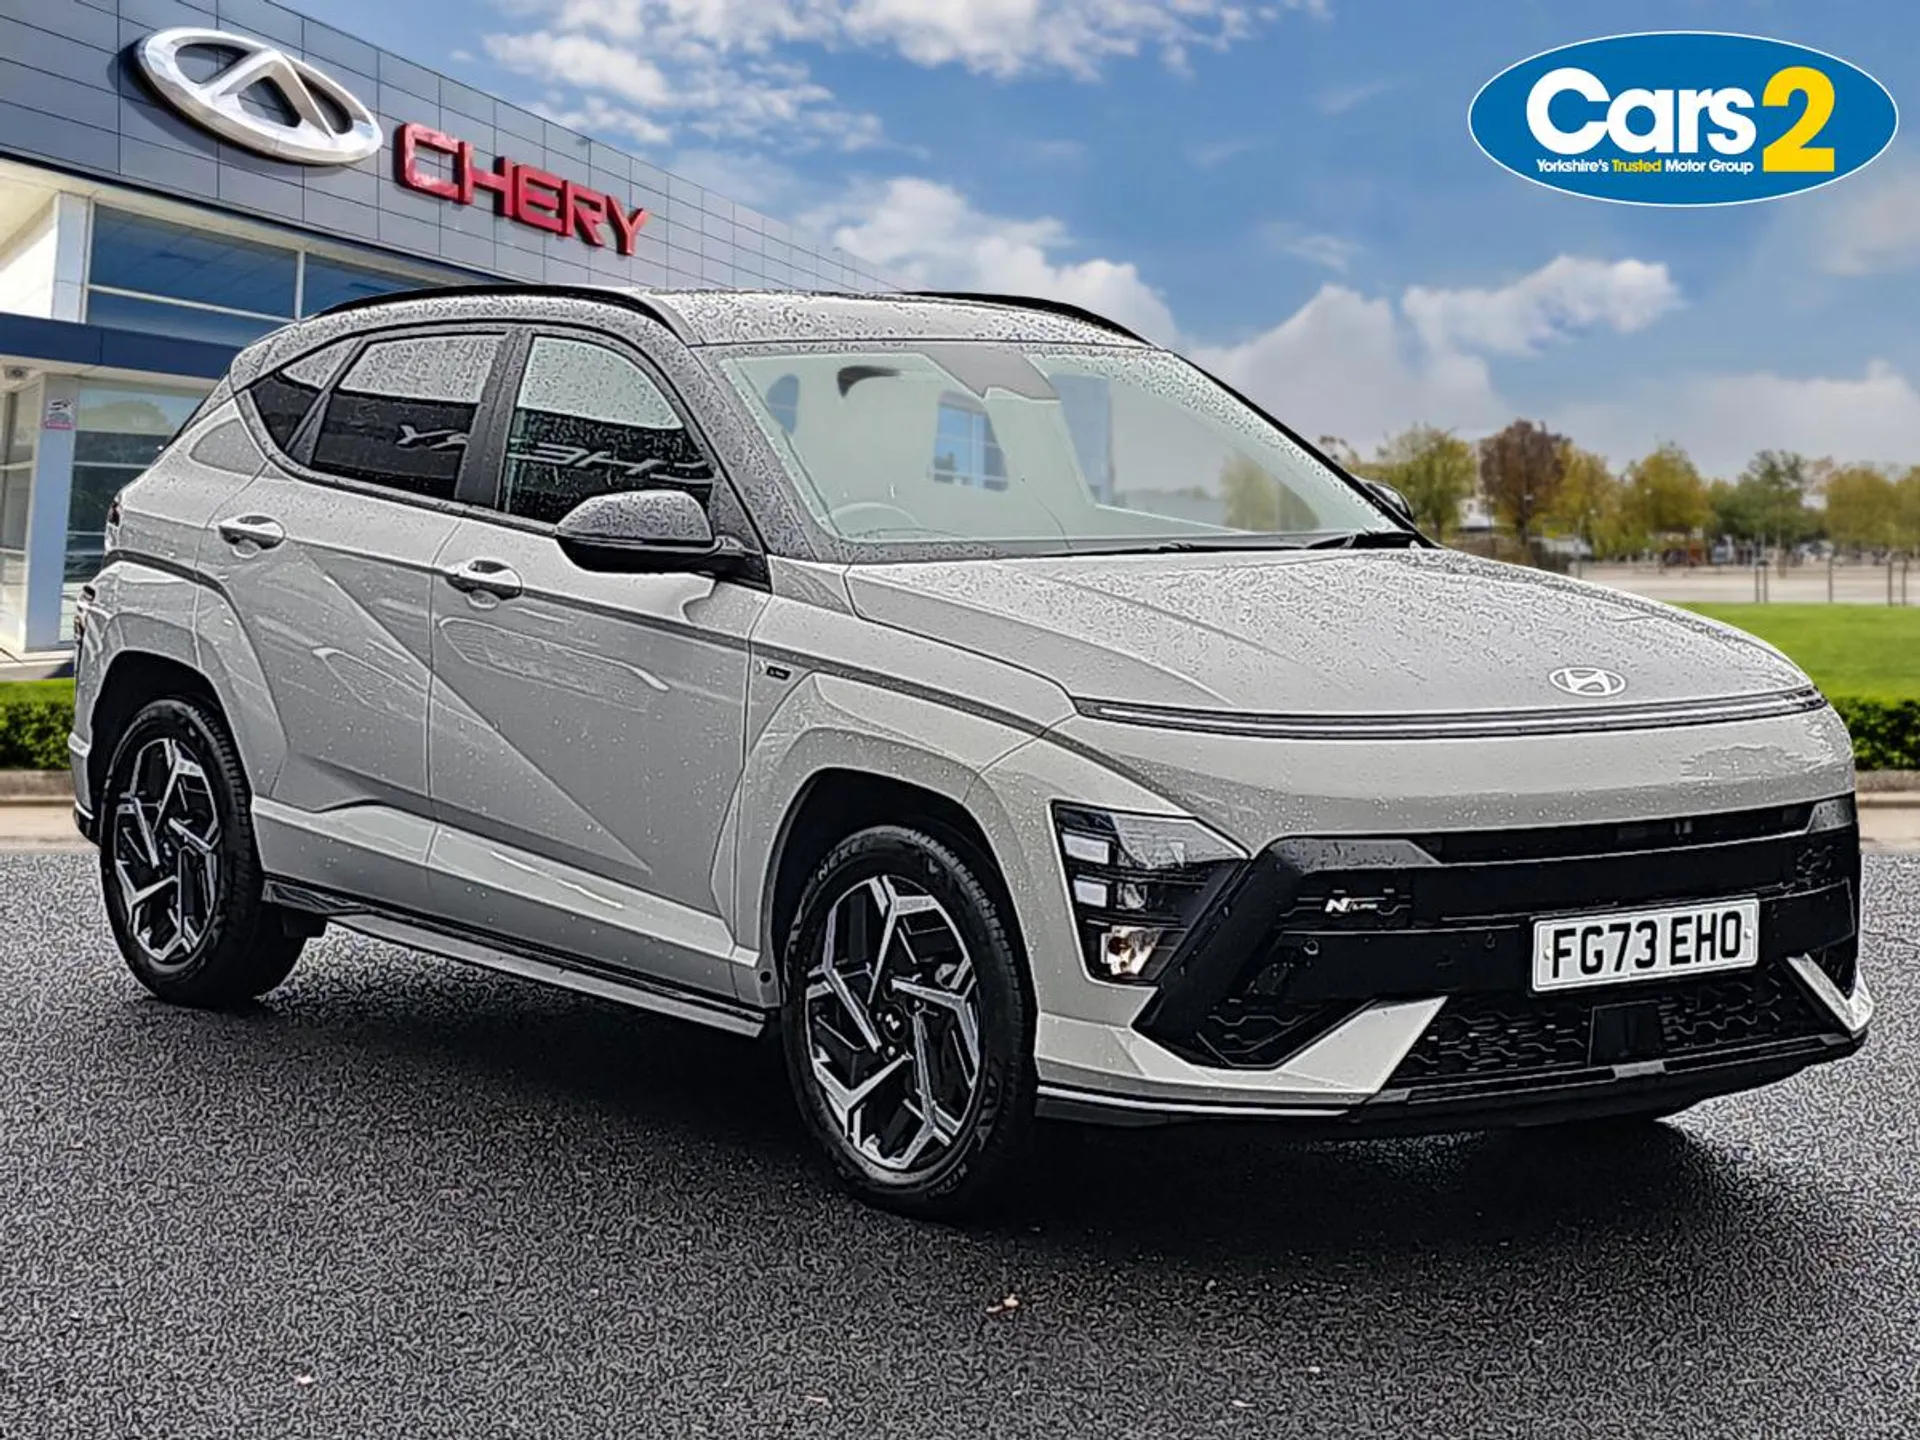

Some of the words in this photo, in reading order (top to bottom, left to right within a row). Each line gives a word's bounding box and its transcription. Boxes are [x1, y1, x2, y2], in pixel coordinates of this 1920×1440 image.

[393, 122, 648, 257] CHERY
[1552, 919, 1658, 979] FG73
[1669, 911, 1742, 966] EHO
